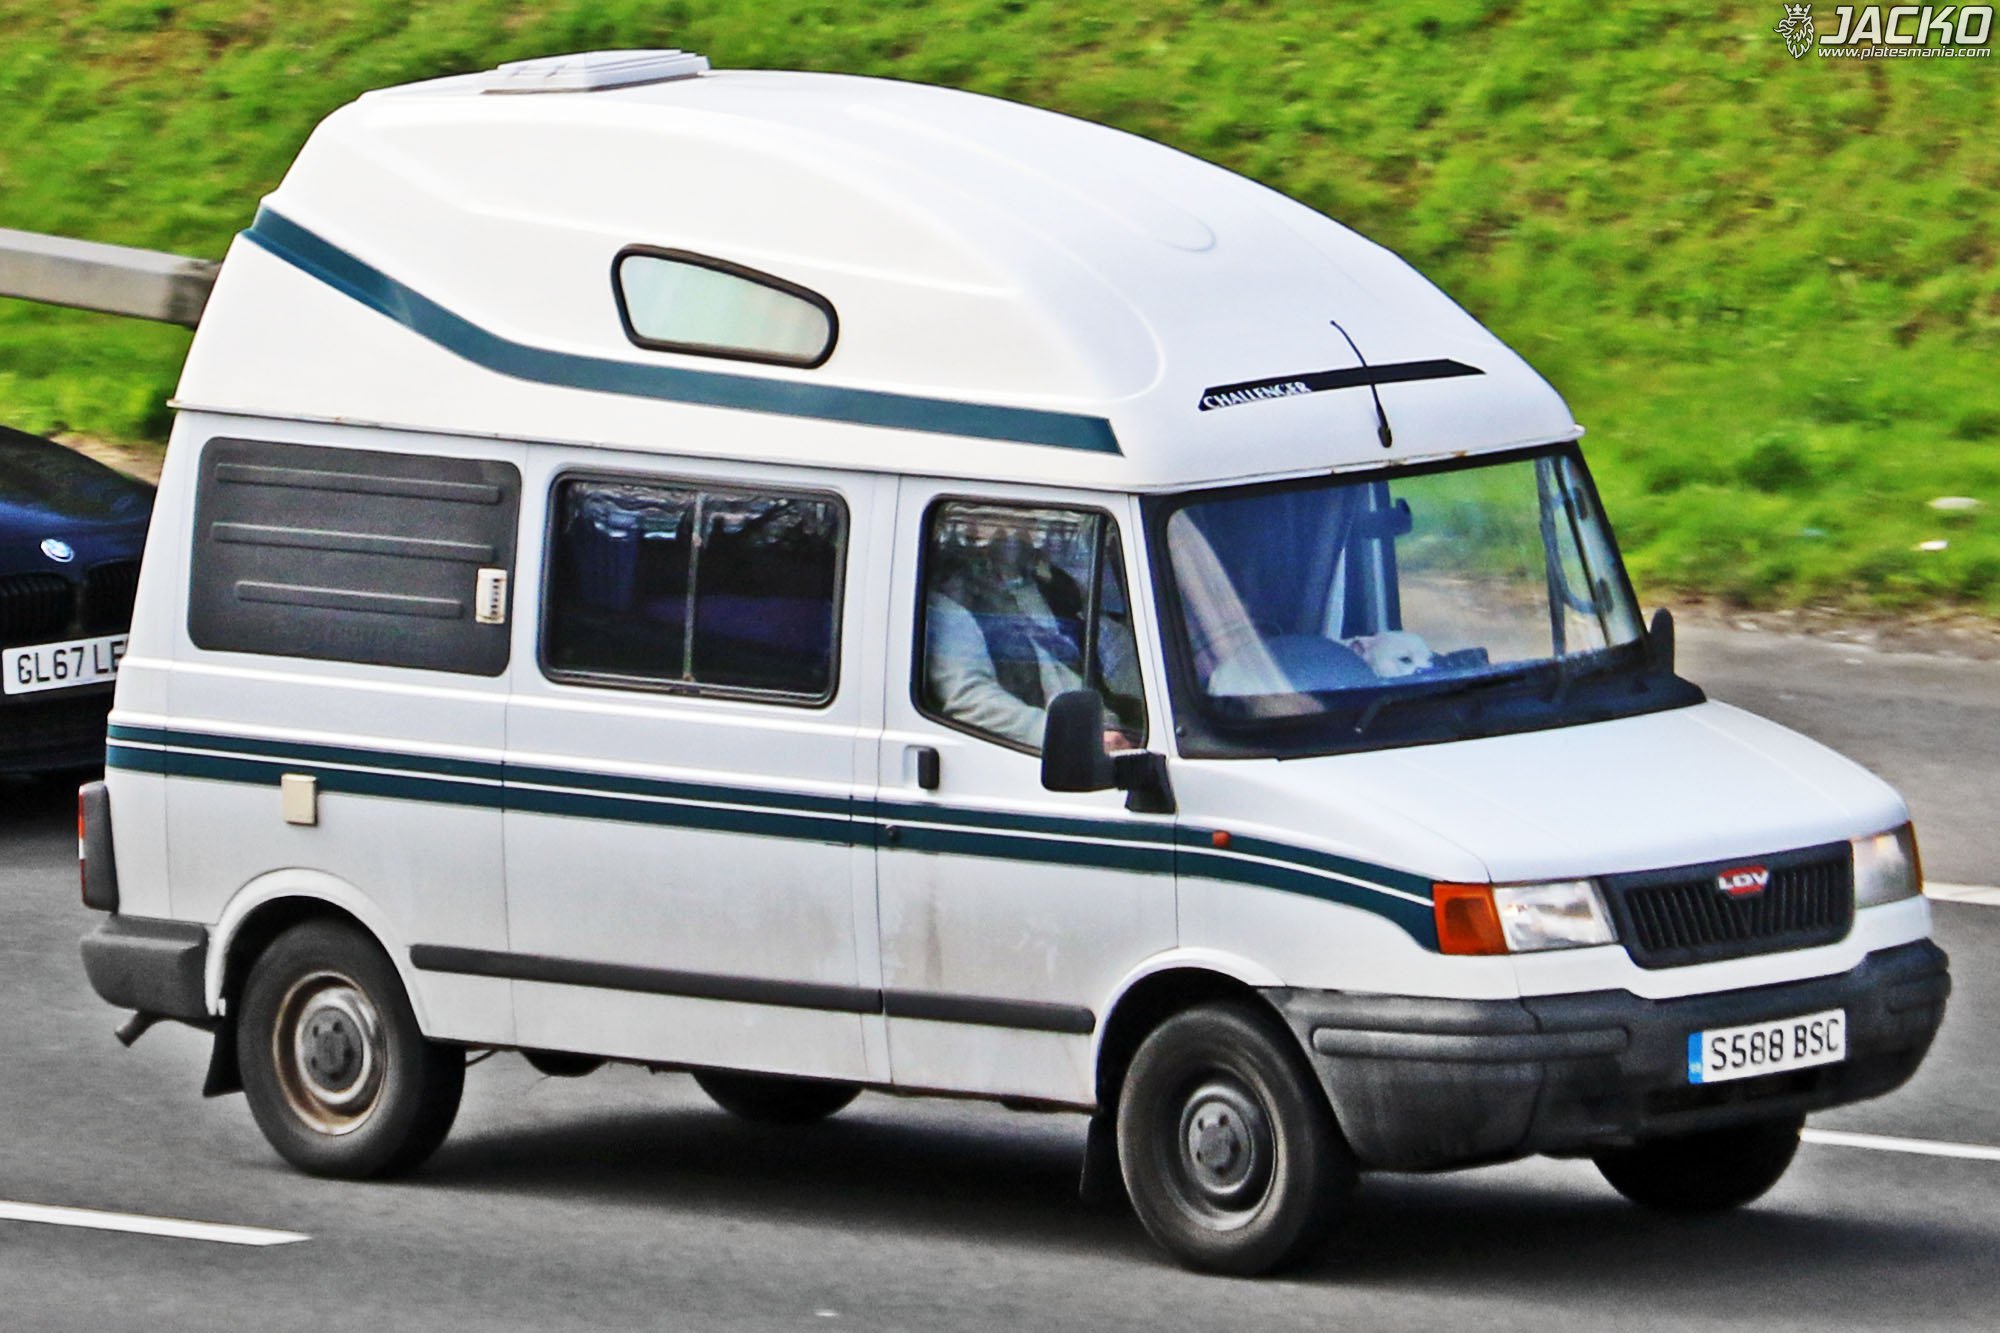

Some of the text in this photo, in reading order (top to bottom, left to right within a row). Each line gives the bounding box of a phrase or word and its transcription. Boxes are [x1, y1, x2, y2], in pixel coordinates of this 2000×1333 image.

[1203, 381, 1312, 408] CHALLENGER
[17, 640, 129, 684] GL67 LE
[1718, 869, 1769, 890] LDV
[1711, 1018, 1839, 1070] S588 BSC
